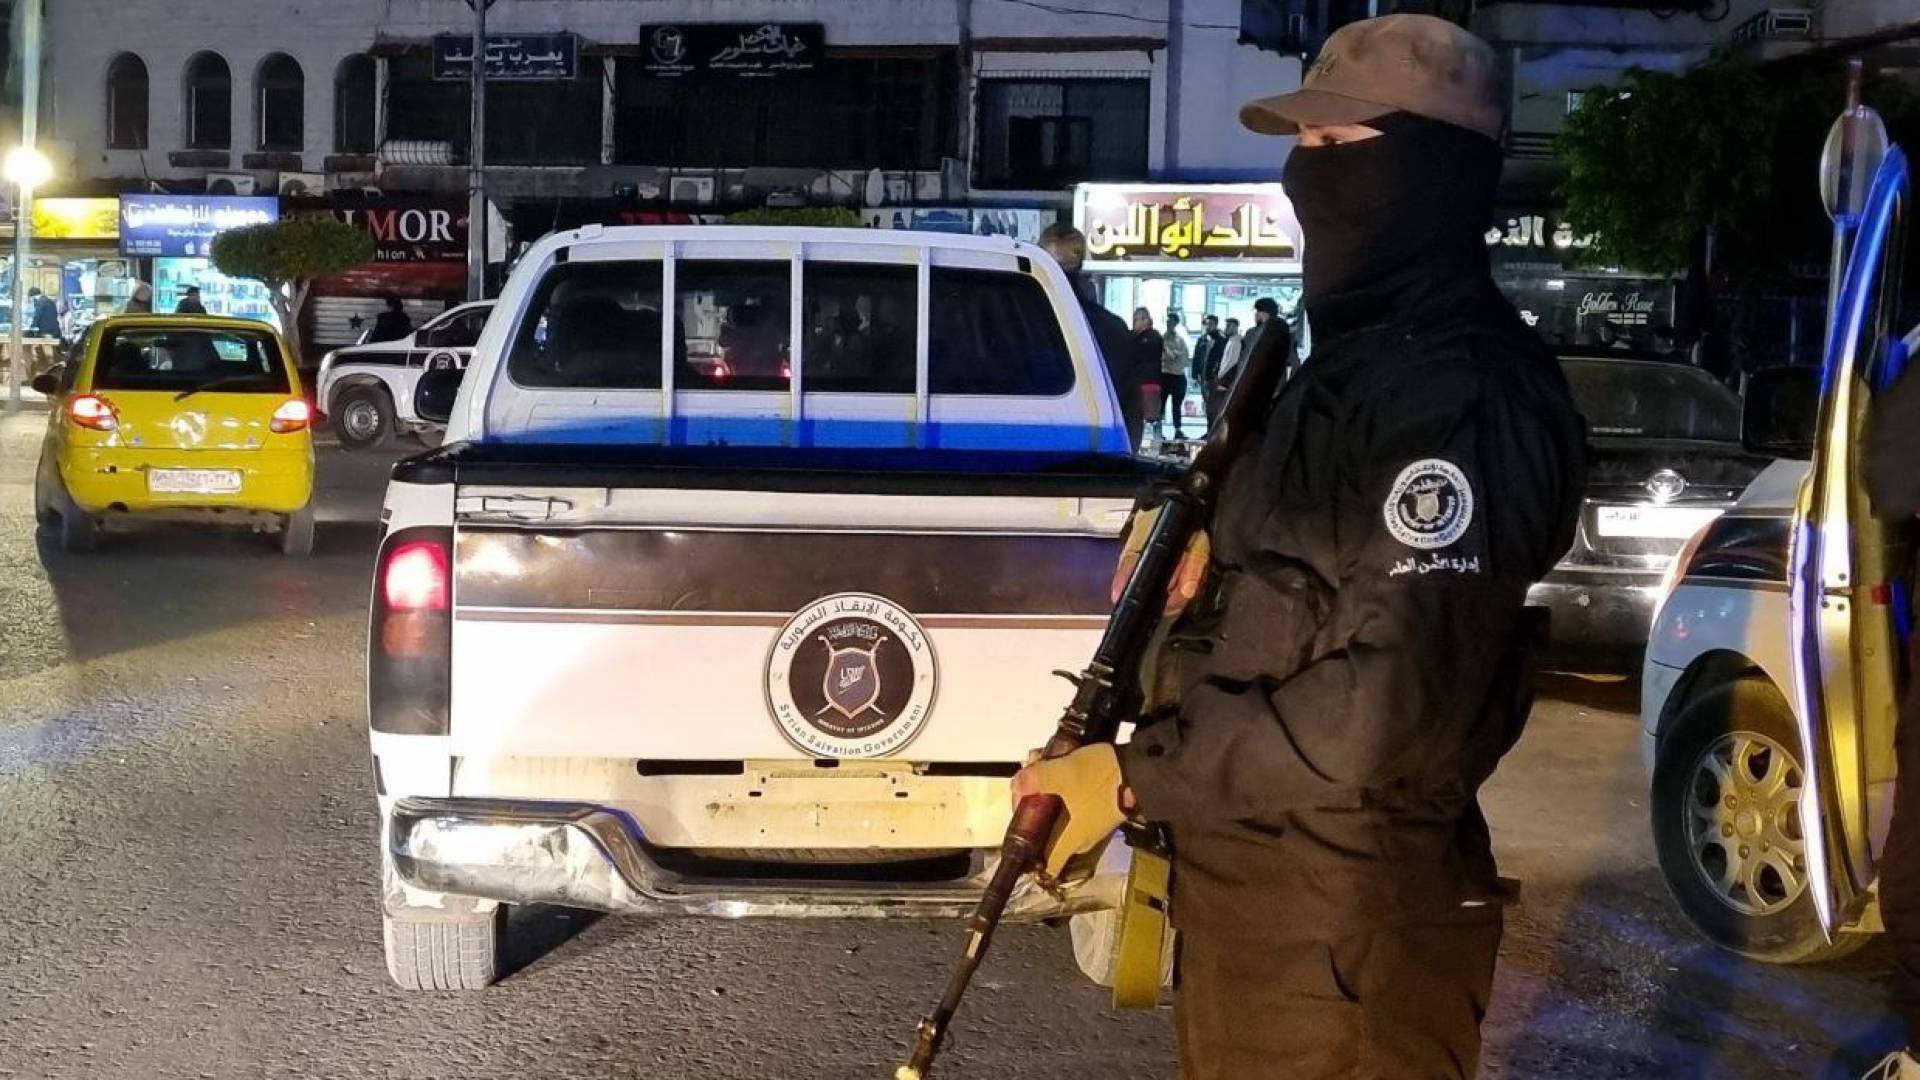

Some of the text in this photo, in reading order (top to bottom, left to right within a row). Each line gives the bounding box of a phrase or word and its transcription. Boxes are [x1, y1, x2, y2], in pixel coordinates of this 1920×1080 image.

[444, 48, 503, 65] يف
[1203, 202, 1295, 248] خالد
[1576, 292, 1619, 316] Golden
[1418, 552, 1450, 574] الأمن
[1451, 555, 1481, 574] إدارة
[834, 600, 880, 616] الإنقاذ
[782, 605, 828, 651] السورية
[884, 610, 922, 652] حكومة
[779, 703, 924, 755] Syrian Salvation Government
